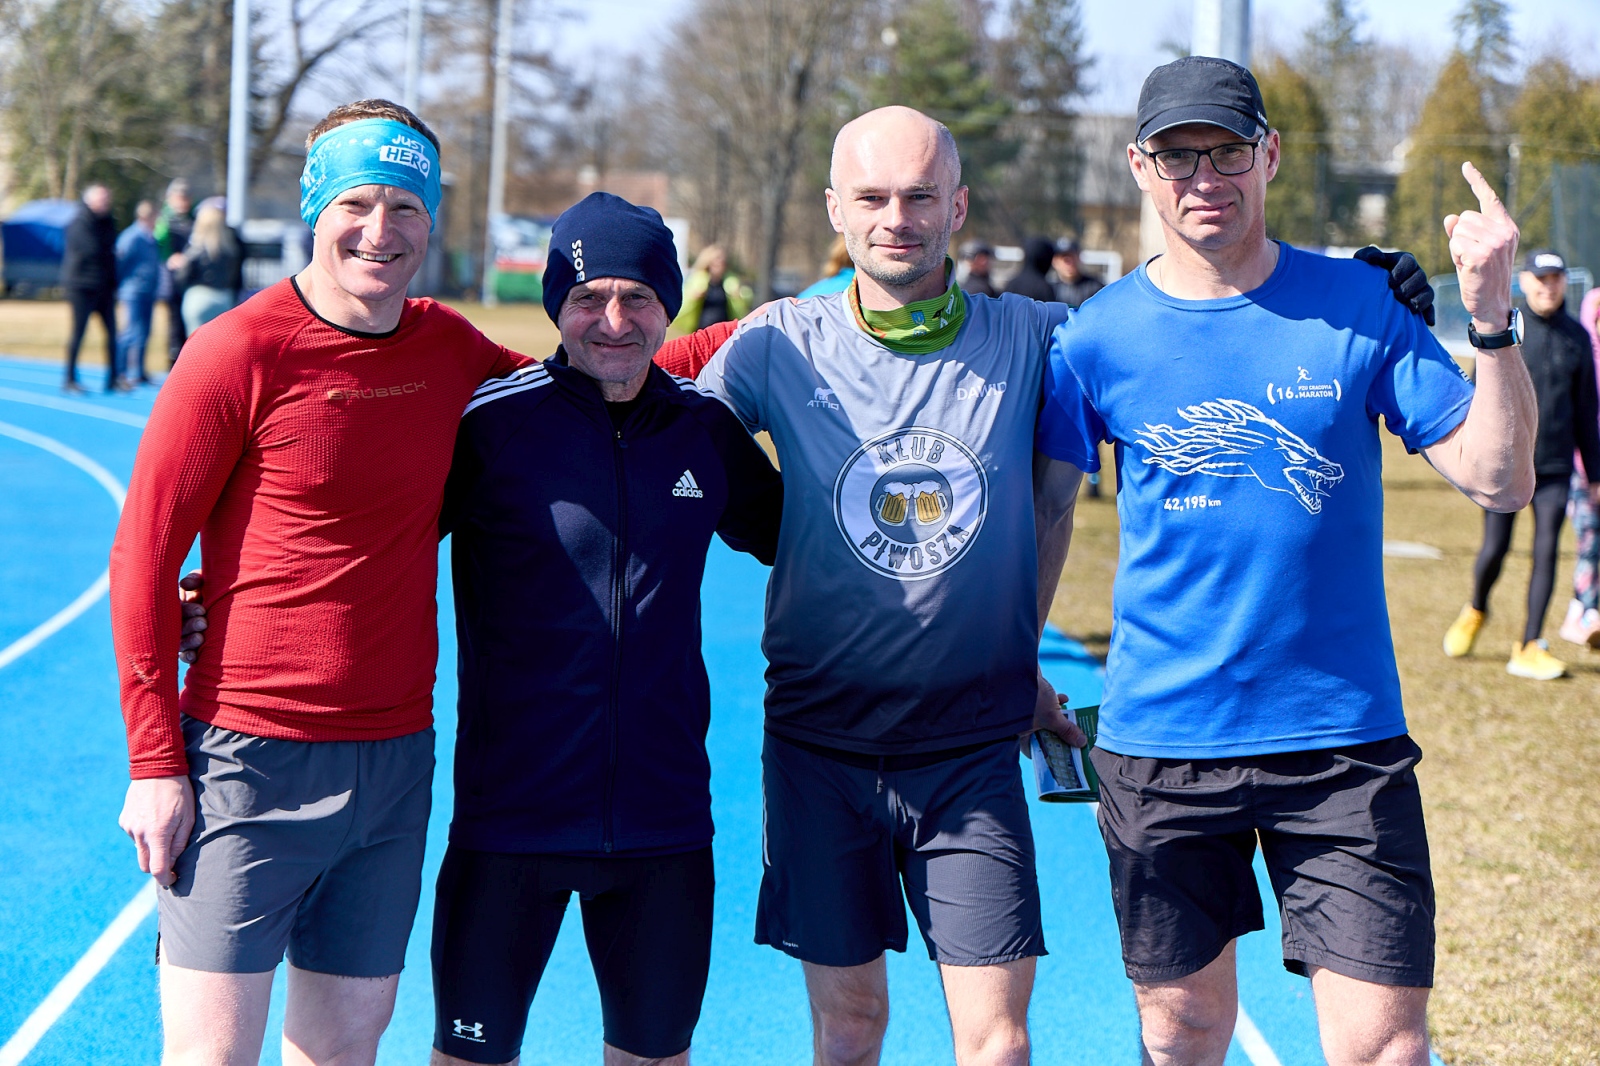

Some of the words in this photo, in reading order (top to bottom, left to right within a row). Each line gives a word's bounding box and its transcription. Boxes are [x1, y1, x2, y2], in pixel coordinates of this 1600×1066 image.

[391, 134, 425, 154] JUST
[386, 147, 429, 174] HERO
[571, 239, 585, 283] BOSS
[327, 381, 428, 400] BRUBECK
[956, 381, 1007, 401] DAWID
[1299, 390, 1334, 399] MARATON
[876, 436, 945, 467] KLUB
[672, 487, 704, 499] adidas
[1163, 495, 1207, 512] 42,195
[1207, 499, 1222, 507] km
[859, 524, 970, 571] PIWOSZA
